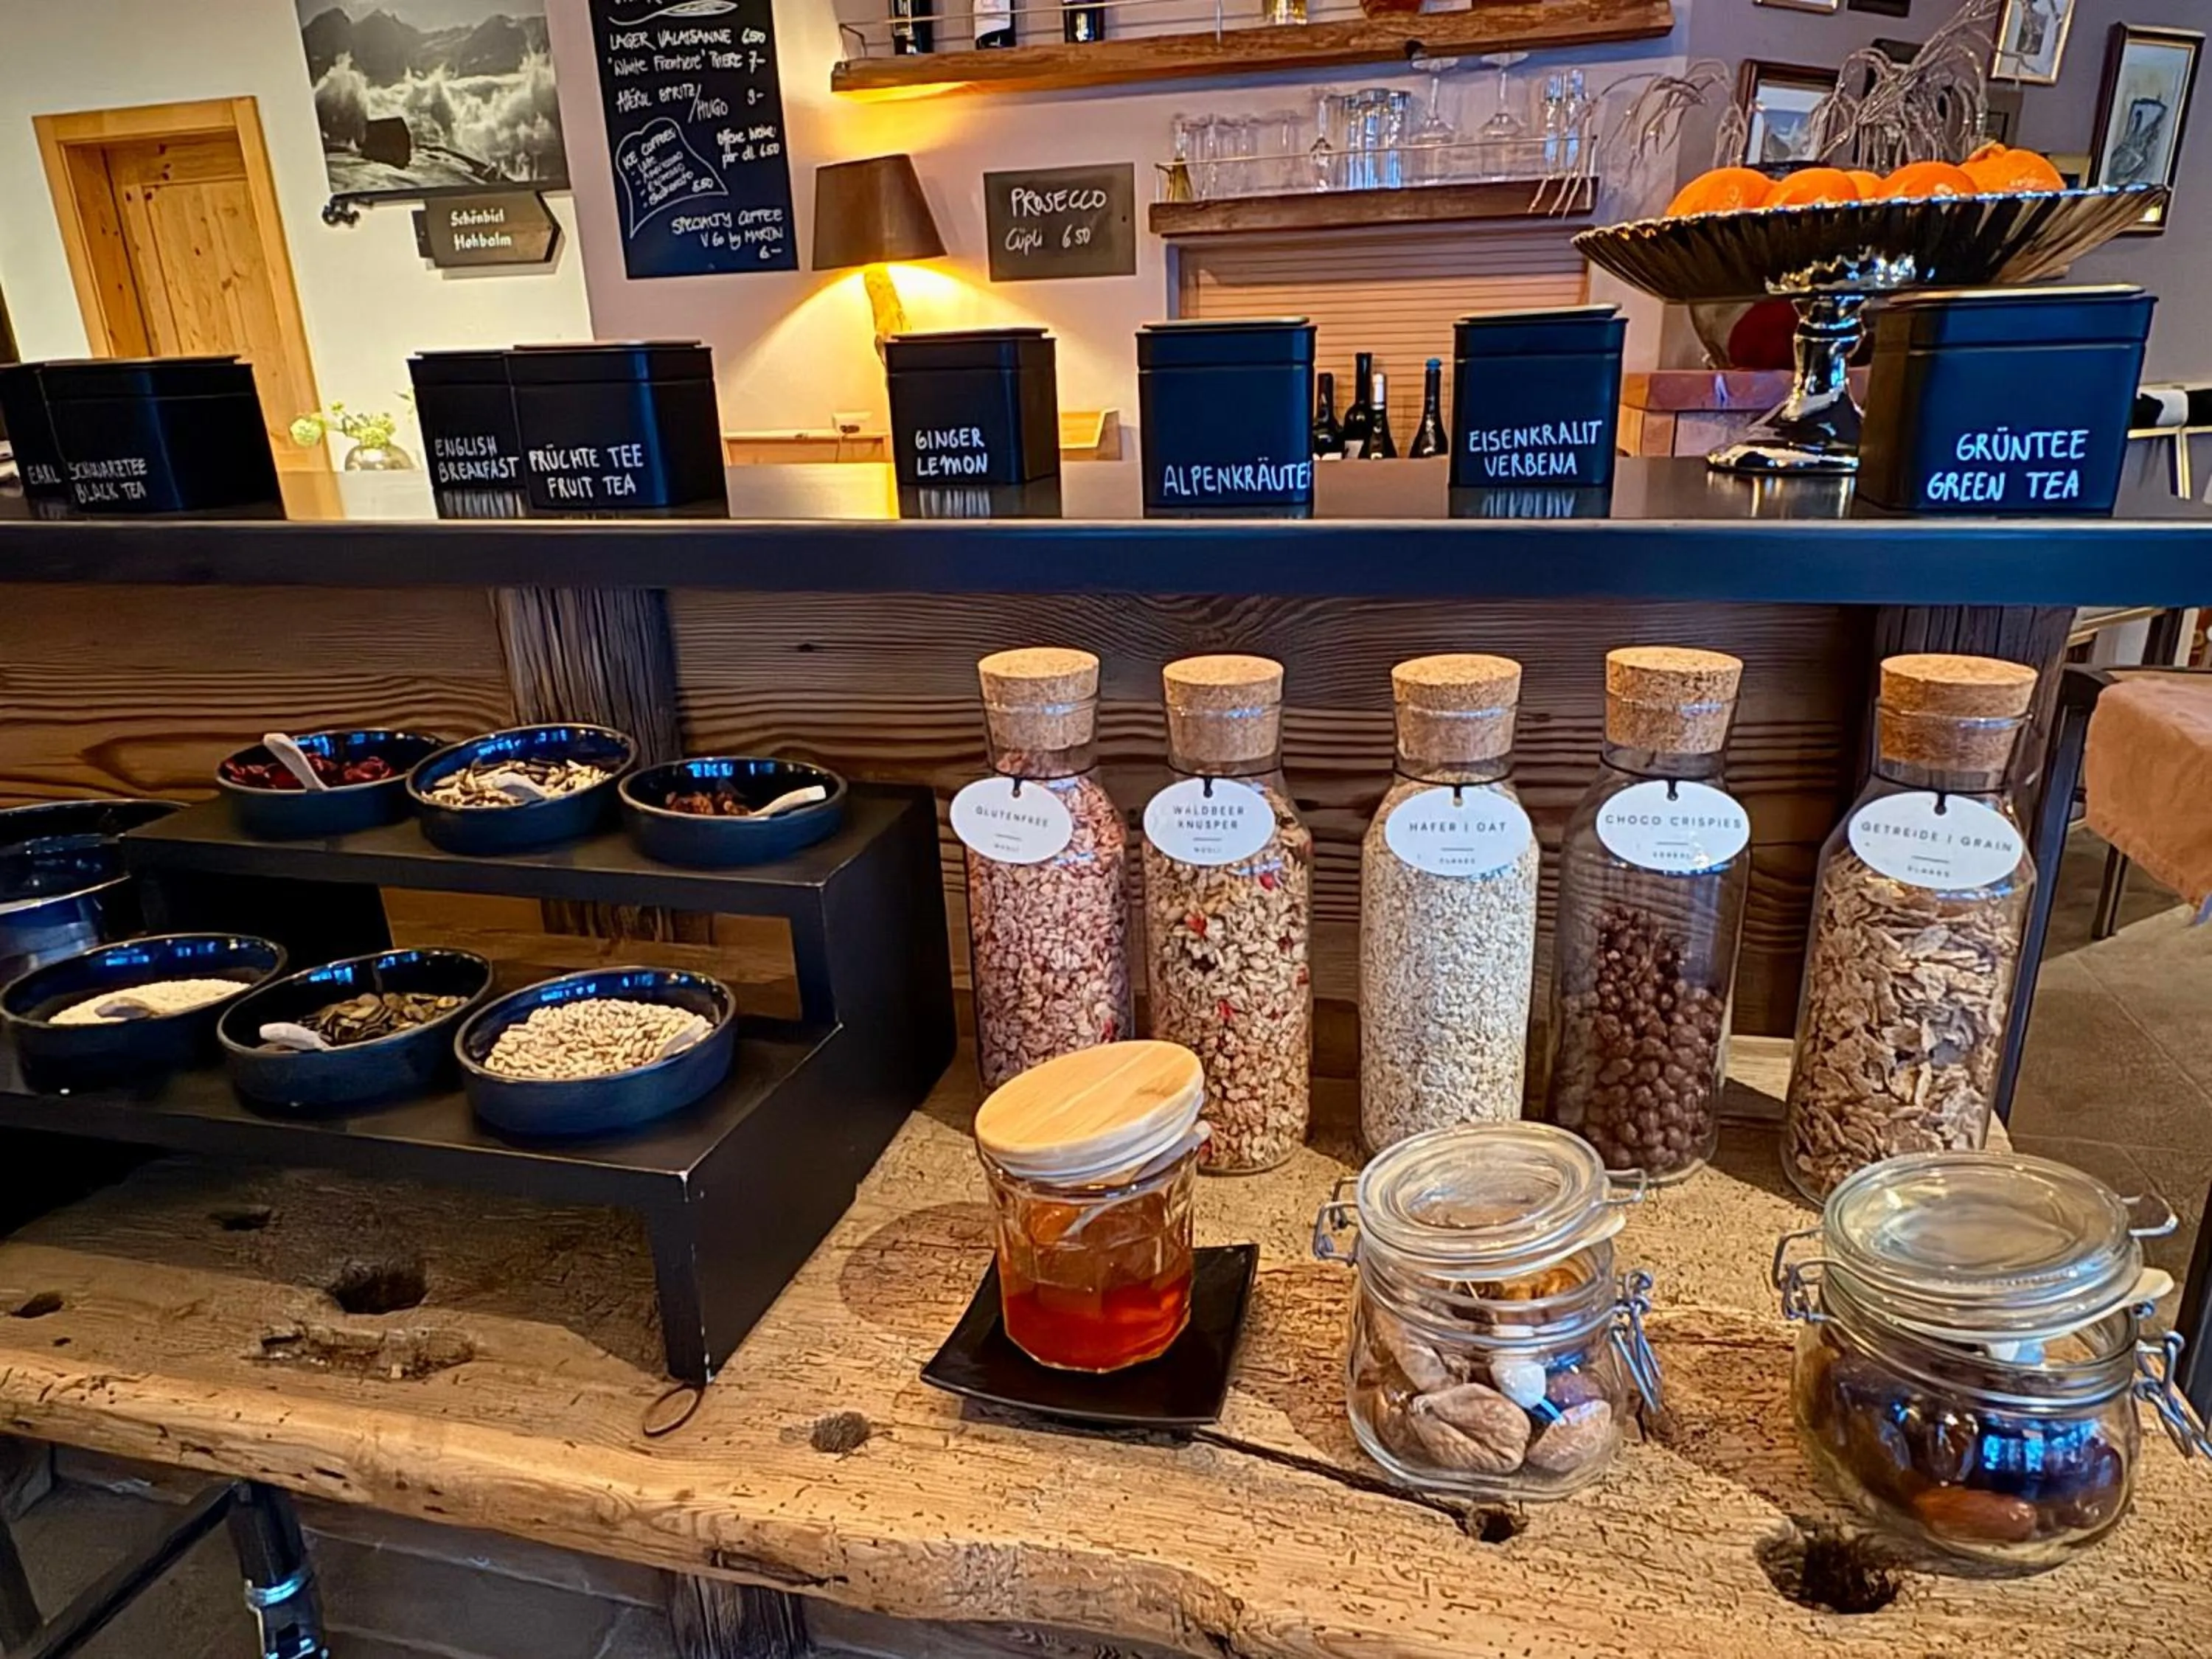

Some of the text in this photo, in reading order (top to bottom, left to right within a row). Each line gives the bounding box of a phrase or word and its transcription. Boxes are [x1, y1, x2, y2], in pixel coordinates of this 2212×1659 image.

[1011, 187, 1107, 218] PROSECCO
[434, 436, 498, 458] ENGLISH
[914, 427, 985, 450] GINGER
[1956, 426, 2090, 462] GRÜNTEE
[438, 456, 519, 483] BREAKFAST
[529, 443, 644, 473] FRÜCHTE TEE
[917, 453, 988, 476] LEMON
[1484, 451, 1578, 478] VERBENA
[74, 481, 147, 504] BLACK TEA
[547, 473, 636, 499] FRUIT TEA
[1927, 469, 2079, 502] GREEN TEA
[1172, 804, 1244, 815] WALDBEER
[1178, 820, 1238, 830] KNUSPER
[1408, 822, 1456, 832] HAFER
[1476, 822, 1507, 832] OAT
[1605, 814, 1742, 830] CHOCO CRISPIES
[1861, 821, 1938, 842] GETREIDE
[1960, 836, 2012, 852] GRAIN
